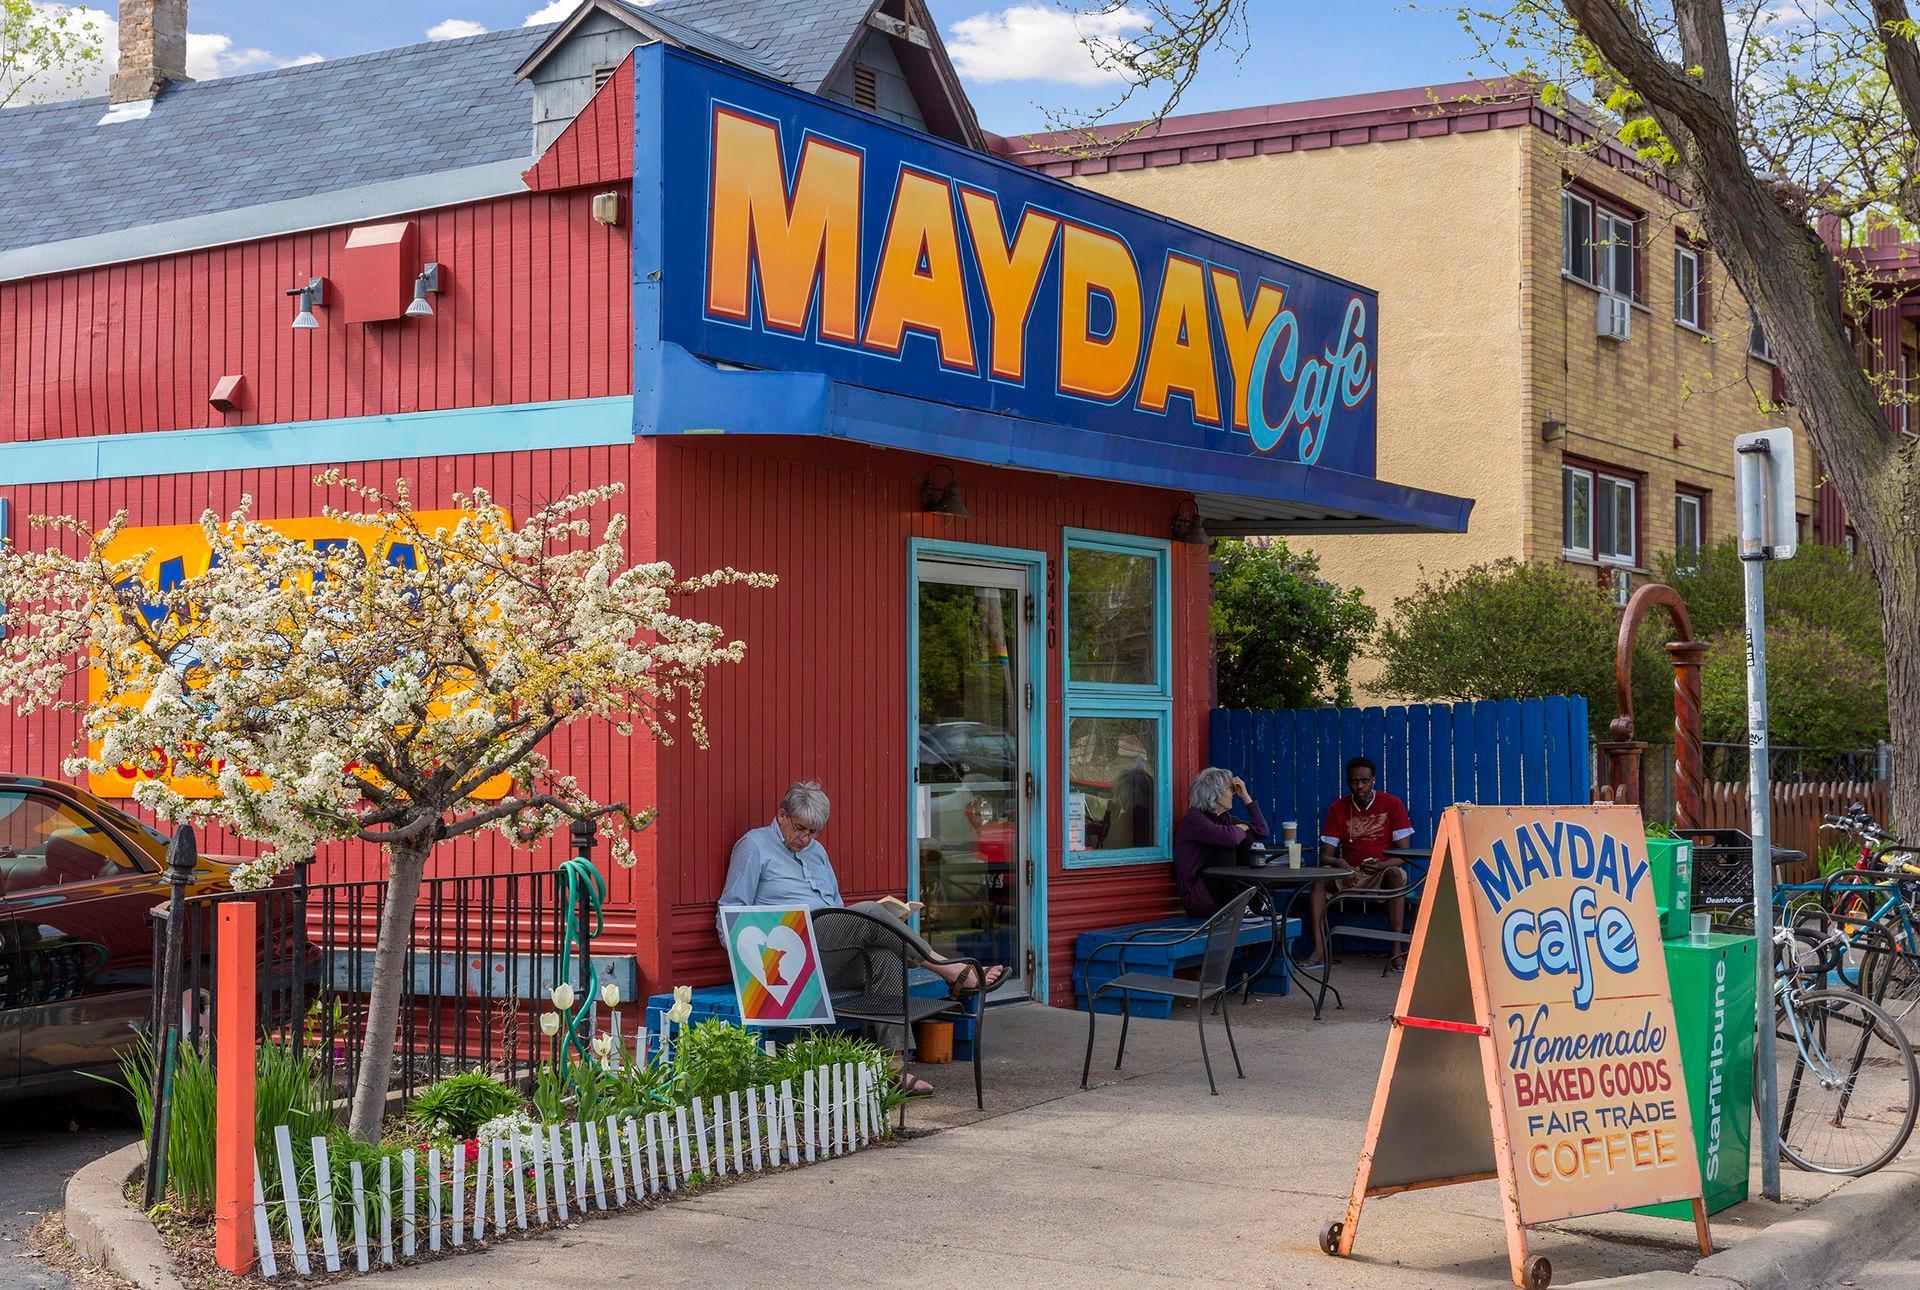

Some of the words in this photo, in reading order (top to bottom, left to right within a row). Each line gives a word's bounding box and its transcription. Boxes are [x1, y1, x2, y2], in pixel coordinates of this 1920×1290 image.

[704, 100, 1289, 435] MAYDAY
[1047, 559, 1056, 649] 3440
[1471, 821, 1649, 914] MAYDAY
[1501, 885, 1640, 1011] cafe
[1508, 1004, 1667, 1070] Homemade
[1707, 959, 1726, 1182] StarTribune
[1514, 1066, 1596, 1108] BAKED
[1598, 1058, 1673, 1098] GOODS
[1527, 1110, 1591, 1137] FAIR
[1594, 1101, 1678, 1130] TRADE
[1529, 1127, 1680, 1186] COFFEE
